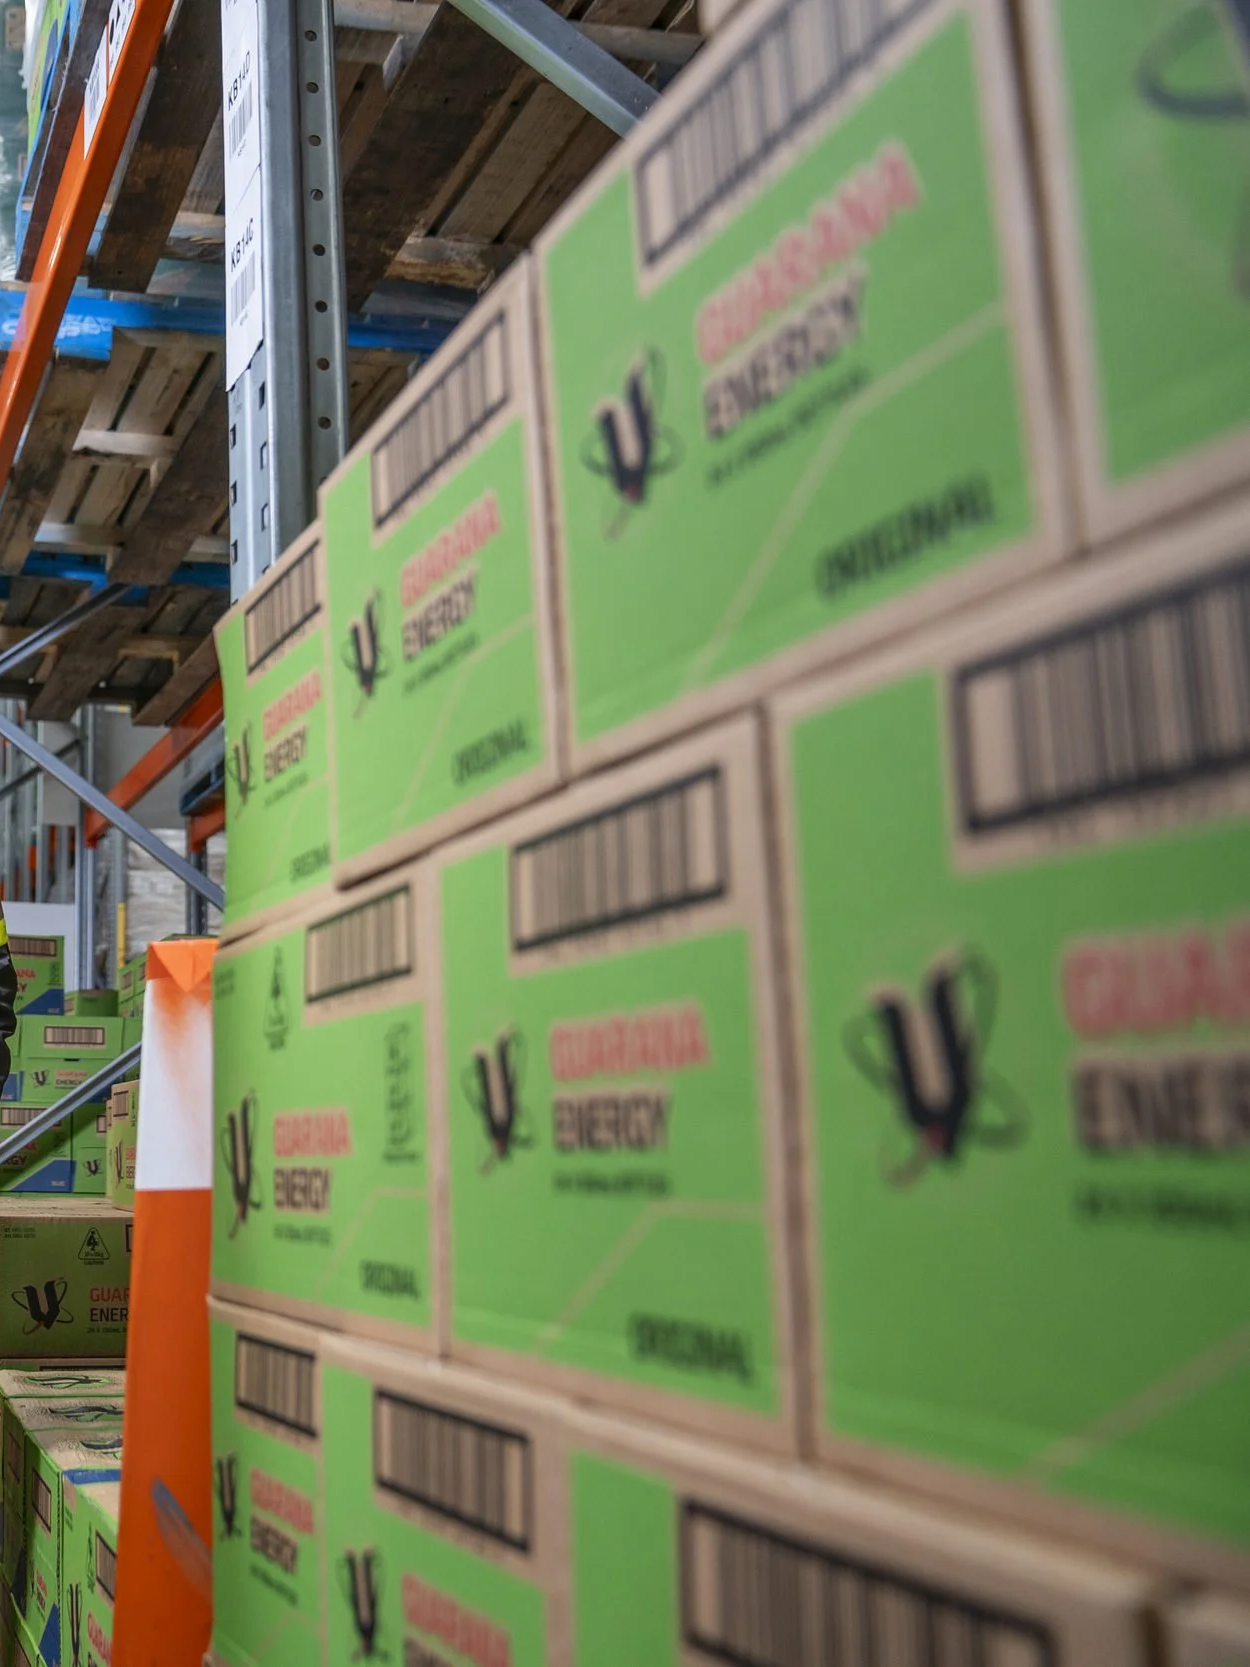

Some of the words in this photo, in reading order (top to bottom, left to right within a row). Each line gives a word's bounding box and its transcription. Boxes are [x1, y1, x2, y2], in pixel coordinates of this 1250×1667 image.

[552, 1004, 711, 1083] GUARANA
[273, 1110, 351, 1158] GUARANA
[552, 1094, 671, 1154] ENERGY
[273, 1165, 330, 1213] ENERGY
[89, 1287, 130, 1303] GUAR
[89, 1307, 128, 1323] ENER
